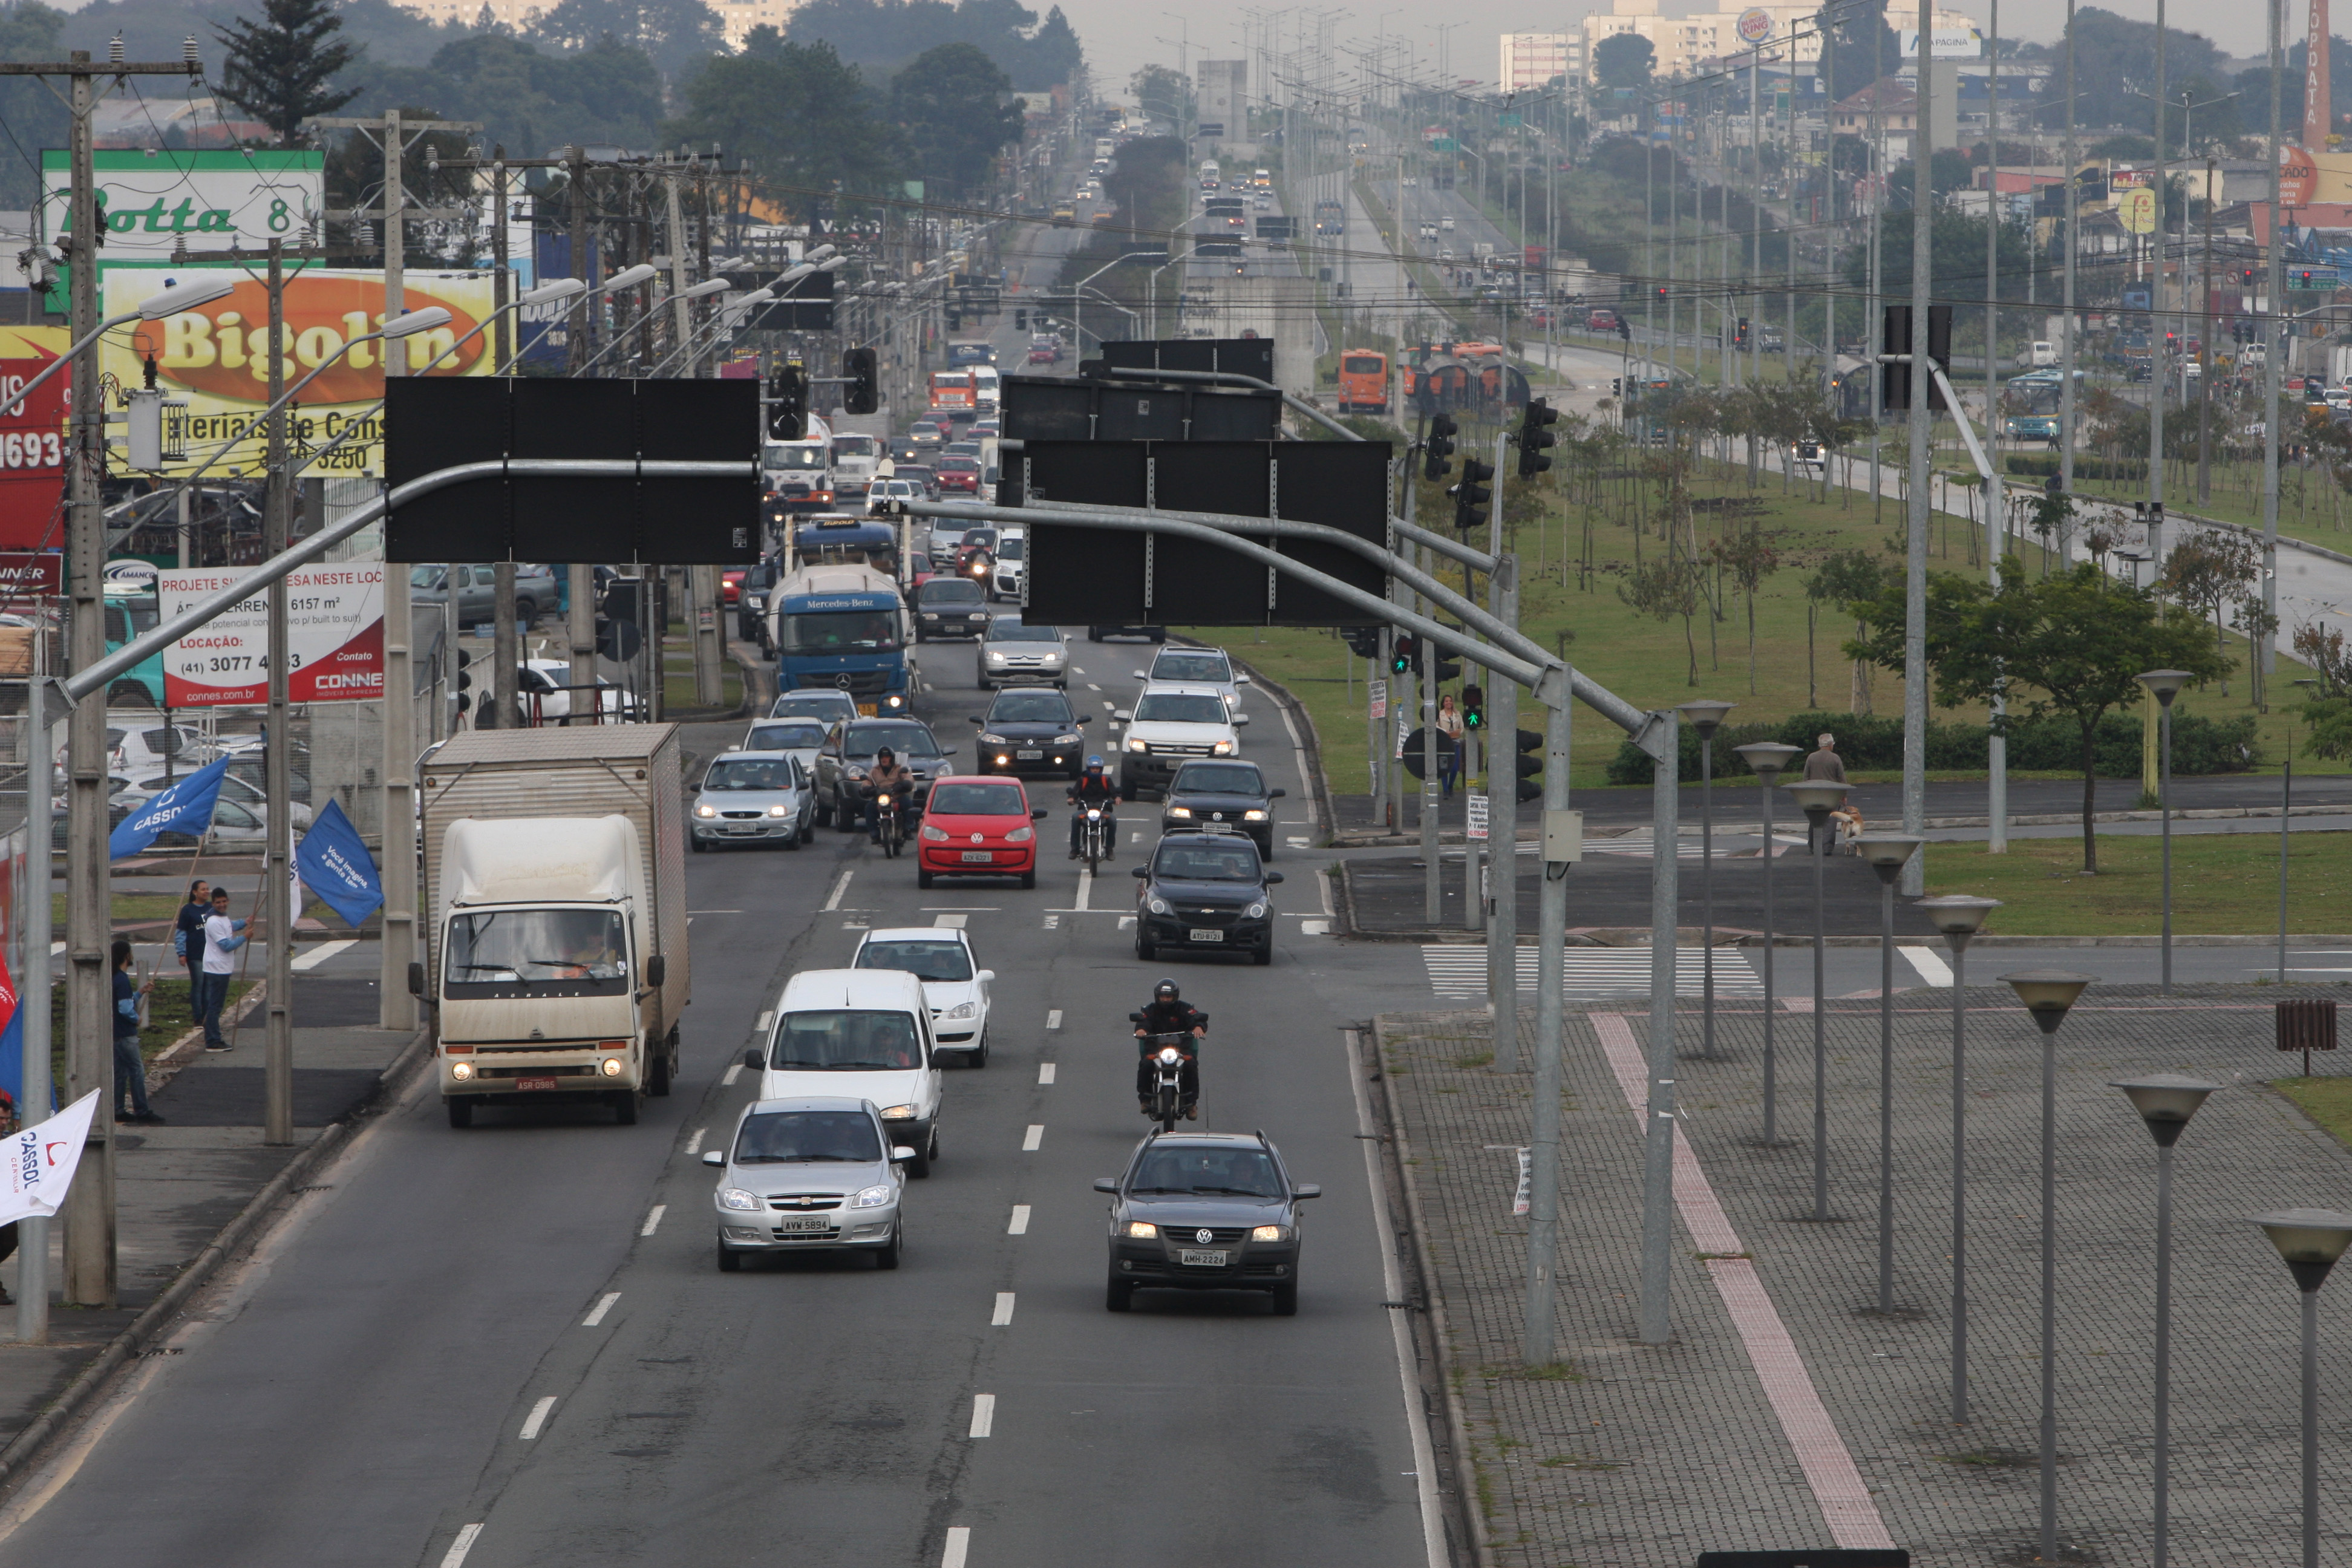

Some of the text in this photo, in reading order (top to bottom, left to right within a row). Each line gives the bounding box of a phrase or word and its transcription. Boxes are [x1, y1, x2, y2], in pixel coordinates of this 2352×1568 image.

[1741, 15, 1767, 28] BURGER
[1743, 21, 1768, 36] KING
[1936, 38, 1968, 47] PÁGINA
[120, 570, 155, 580] AMANCO
[162, 578, 219, 592] PROJETE
[314, 573, 353, 586] NESTE
[291, 598, 320, 610] 6157
[807, 599, 874, 609] Mercedes-Benz
[212, 618, 250, 630] potencial
[312, 615, 330, 624] built
[332, 615, 341, 624] to
[180, 636, 243, 650] LOCAÇÃO:
[336, 652, 373, 662] Contato
[181, 662, 204, 676] (41)
[210, 656, 252, 672] 3077
[187, 689, 255, 702] connes.com.br
[132, 805, 188, 831] CASSO
[327, 845, 344, 864] Você
[325, 858, 345, 878] gente
[21, 1131, 40, 1191] CASSOL
